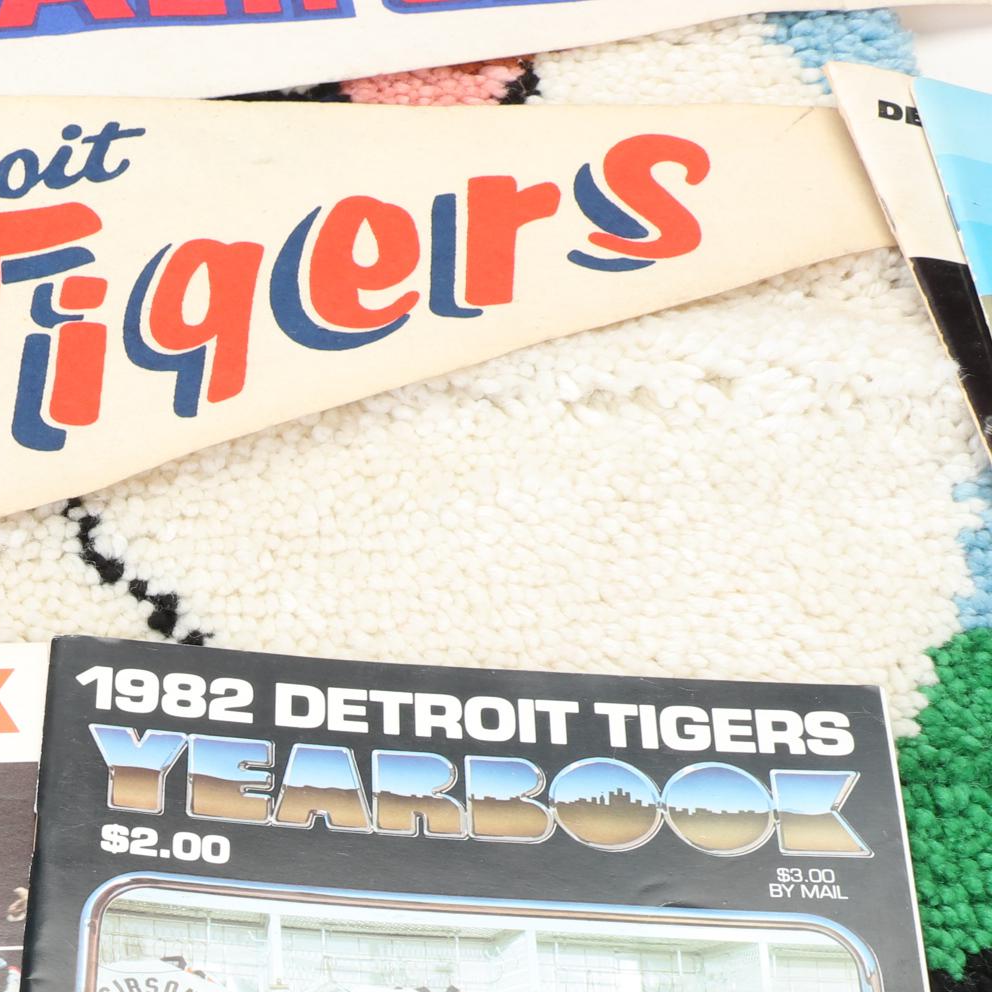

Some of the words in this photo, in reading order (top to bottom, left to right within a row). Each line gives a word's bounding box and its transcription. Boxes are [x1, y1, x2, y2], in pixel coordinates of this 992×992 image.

[75, 665, 254, 725] 1982
[274, 681, 579, 746] DETROIT
[594, 701, 855, 757] TIGERS
[88, 723, 875, 859] YEARBOOK
[100, 823, 231, 865] $2.00
[769, 883, 797, 898] BY
[801, 884, 849, 900] MAIL
[776, 866, 836, 884] $3.00
